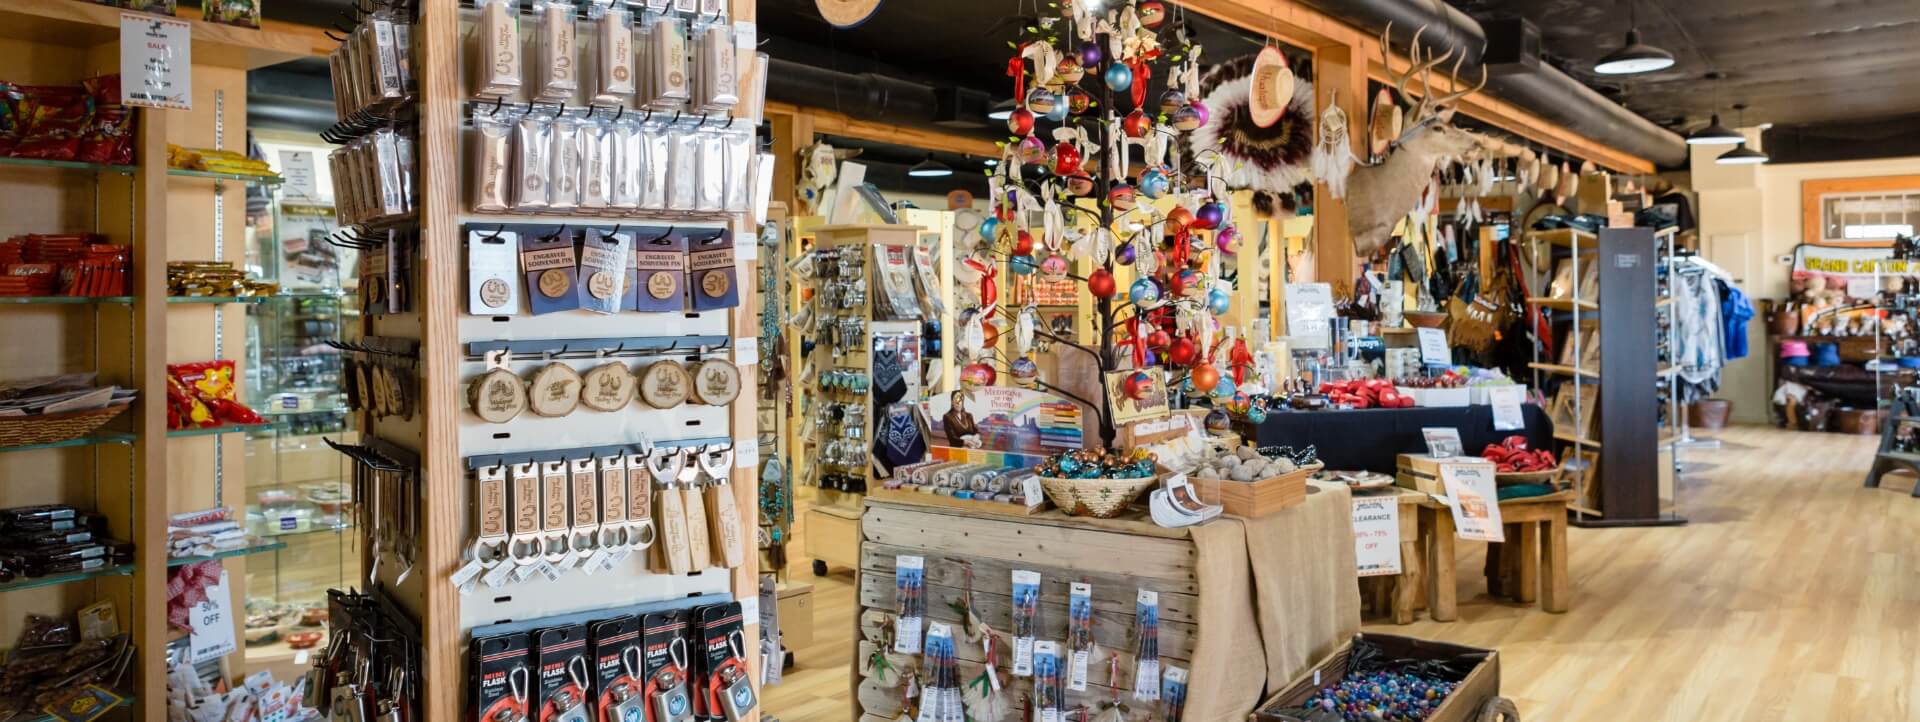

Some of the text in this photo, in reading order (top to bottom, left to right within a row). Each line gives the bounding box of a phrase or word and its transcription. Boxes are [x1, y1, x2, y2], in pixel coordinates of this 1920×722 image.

[1804, 256, 1848, 272] GRAND
[1353, 514, 1391, 522] LEARANCE
[204, 613, 220, 626] OFF
[708, 641, 728, 652] FLASK
[647, 648, 668, 658] FLASK
[600, 659, 620, 670] FLASK
[543, 668, 566, 678] FLASK
[482, 677, 506, 688] FLASK
